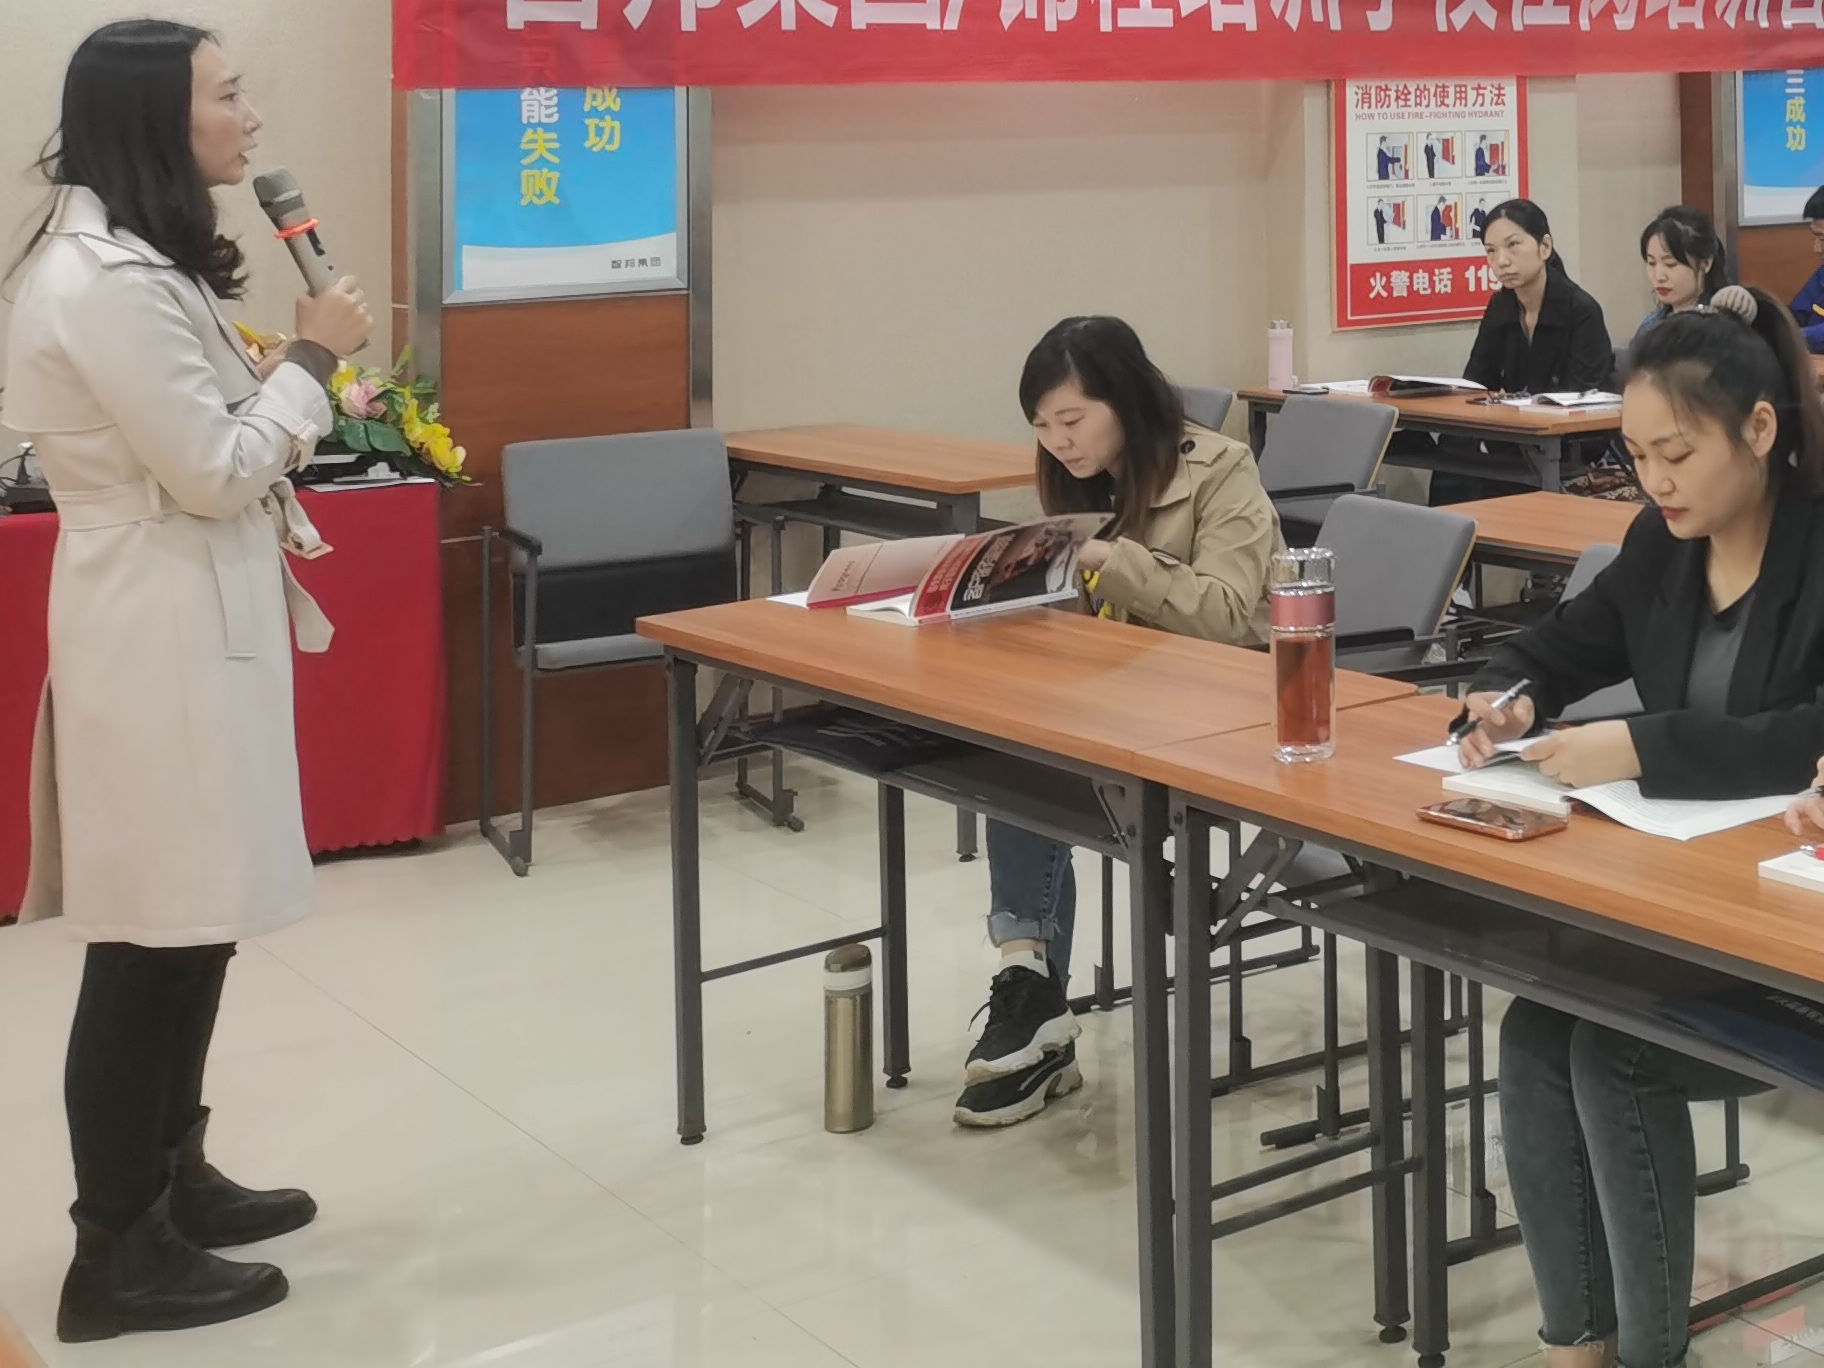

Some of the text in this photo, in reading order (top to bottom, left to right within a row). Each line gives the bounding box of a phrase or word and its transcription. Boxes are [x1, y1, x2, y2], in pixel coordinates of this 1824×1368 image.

[1355, 83, 1507, 110] 消防栓的使用方法
[1355, 113, 1374, 121] HOW
[1377, 112, 1388, 120] TO
[1390, 111, 1406, 120] USE
[1468, 110, 1505, 119] HYDRANT
[611, 256, 662, 269] 智邦集团
[1369, 266, 1453, 299] 火警电话
